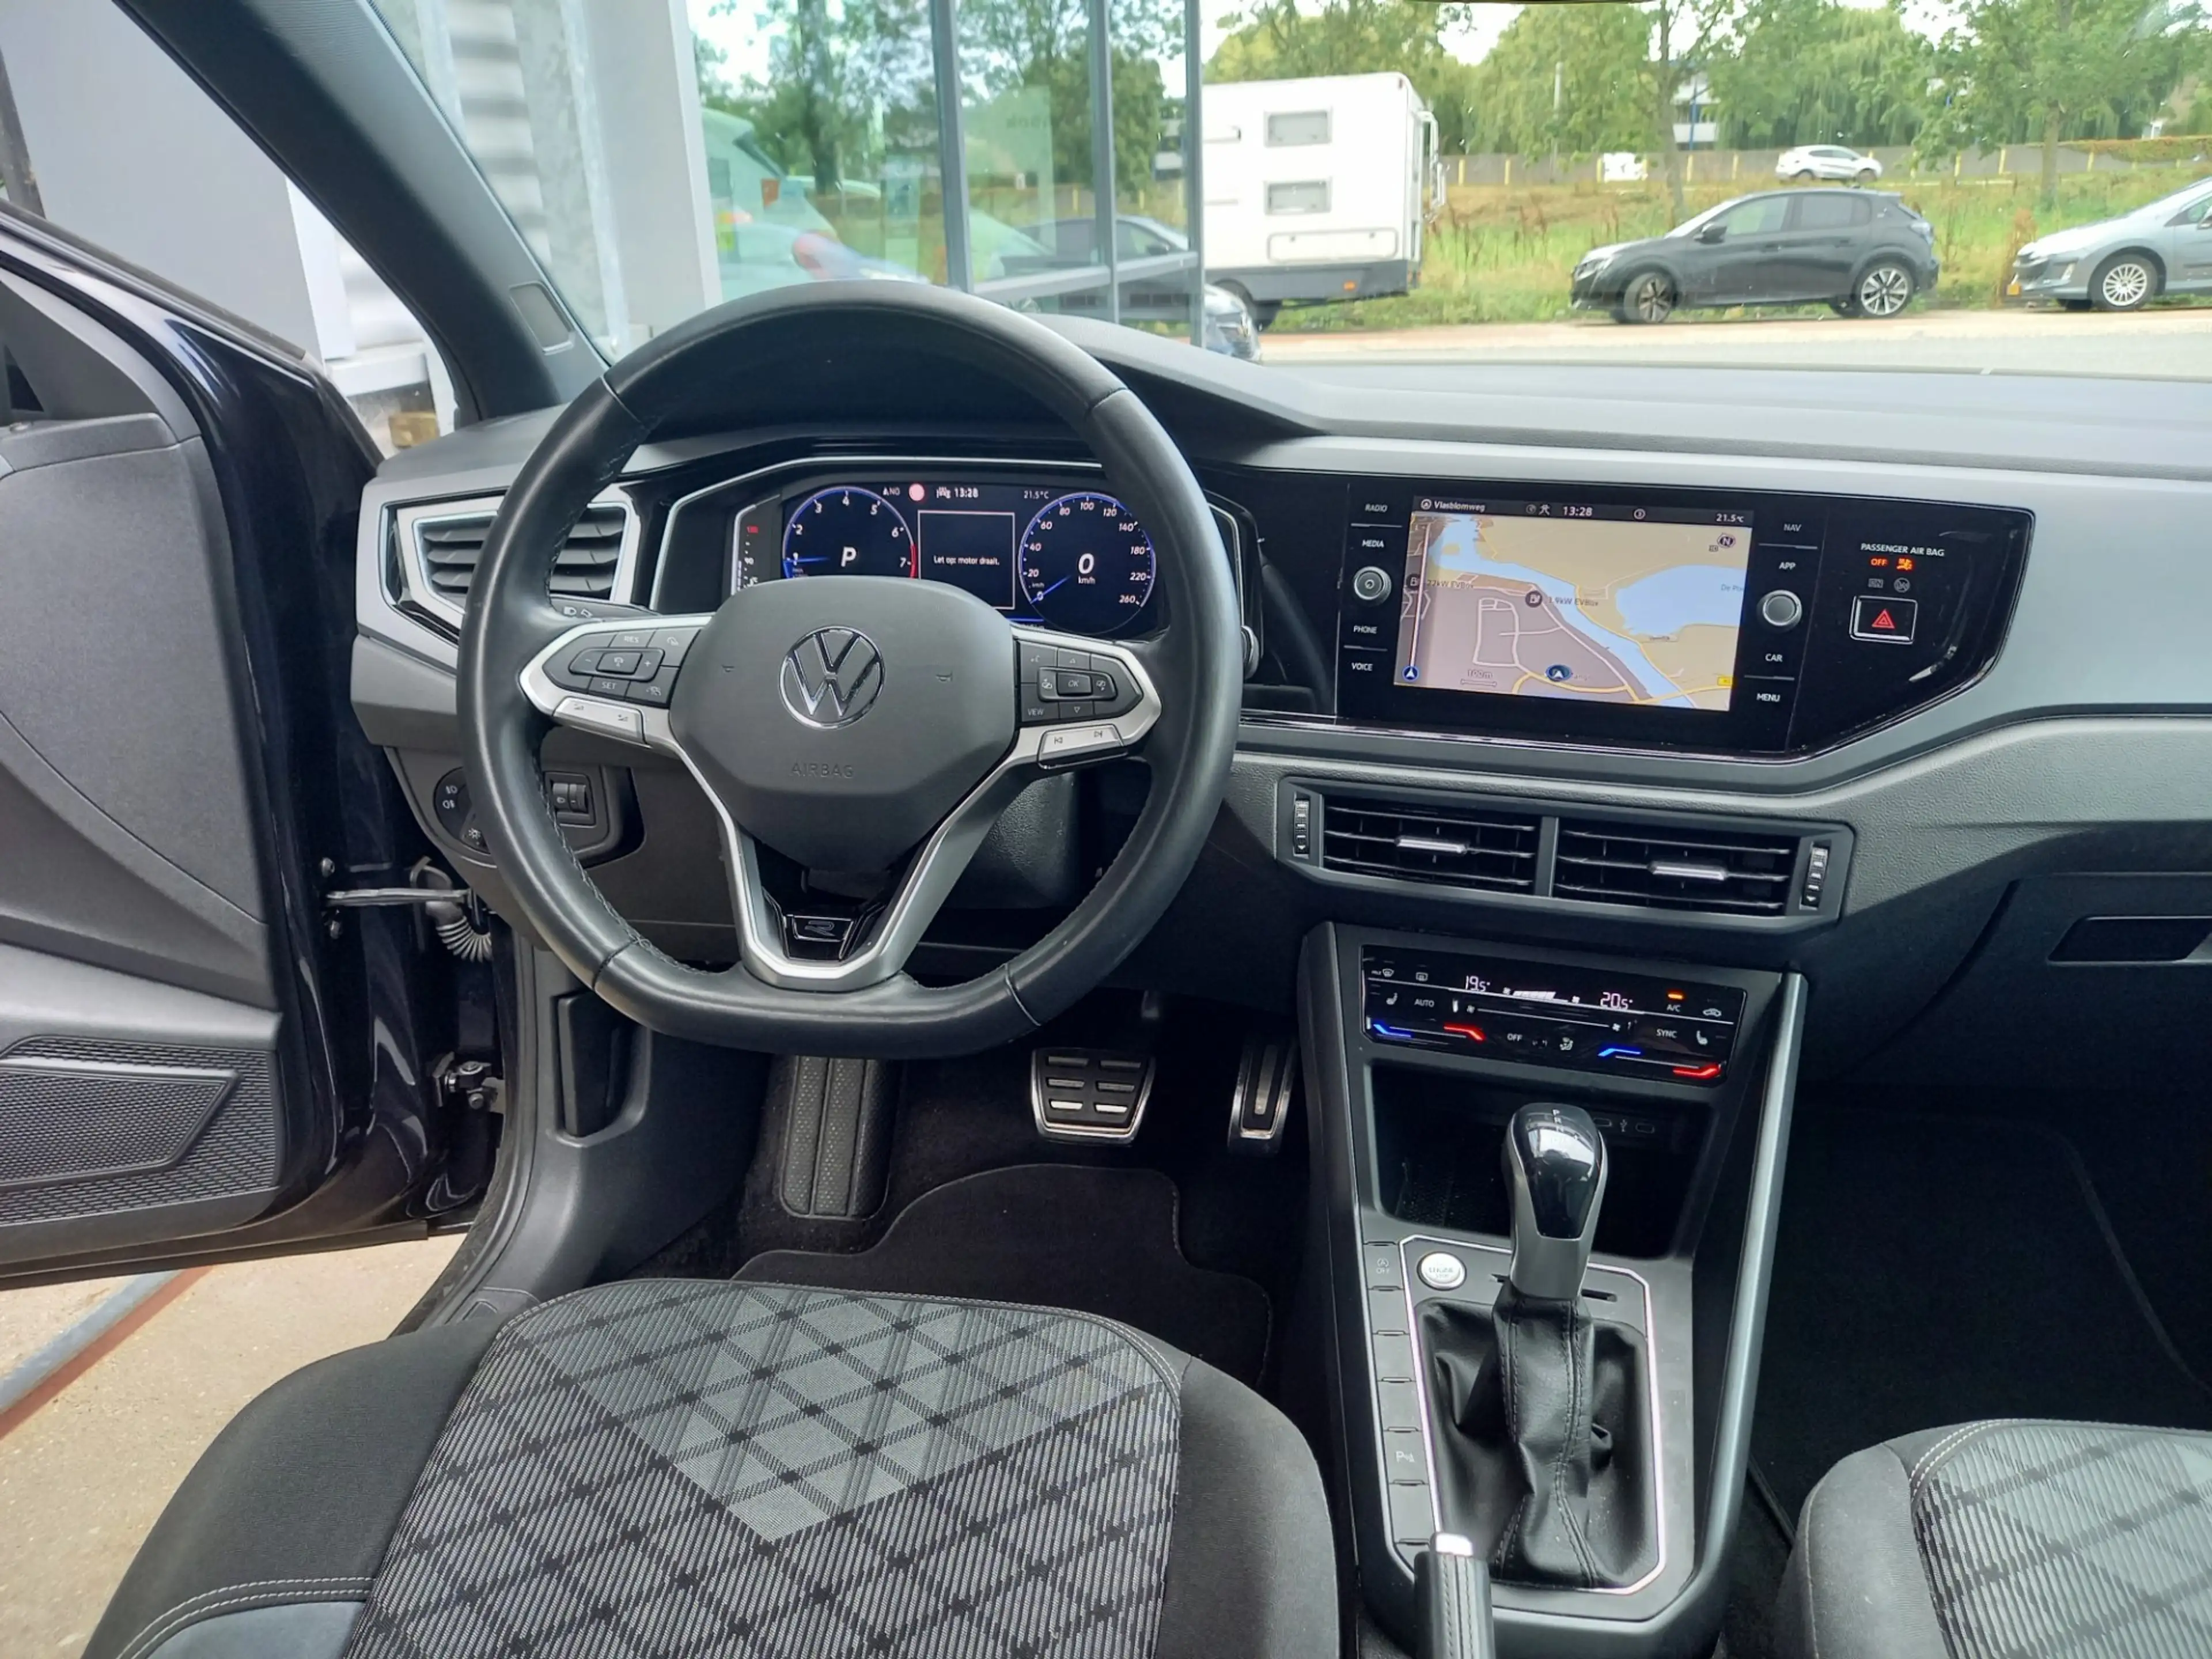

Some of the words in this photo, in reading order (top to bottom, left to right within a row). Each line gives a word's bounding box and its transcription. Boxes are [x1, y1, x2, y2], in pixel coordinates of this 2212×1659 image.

[955, 487, 979, 498] 13:28
[842, 496, 850, 506] 4
[815, 502, 822, 514] 3
[870, 504, 878, 515] 5
[1059, 507, 1070, 516] 80
[1080, 502, 1094, 511] 100
[1365, 503, 1388, 513] RADIO
[1562, 505, 1593, 517] 13:28
[1103, 507, 1118, 517] 120
[796, 524, 803, 535] 2
[1040, 521, 1053, 530] 60
[1119, 522, 1134, 532] 140
[1783, 523, 1801, 532] NAV
[891, 527, 899, 537] 6
[1029, 543, 1041, 552] 40
[1362, 539, 1385, 548] MEDIA
[1130, 546, 1145, 555] 180
[1861, 543, 1908, 554] PASSENGER
[1910, 547, 1925, 555] AIR
[1926, 548, 1945, 557] BAG
[840, 547, 857, 567] P
[900, 557, 907, 567] 7
[957, 556, 979, 565] motor
[1078, 553, 1094, 574] 0
[1778, 561, 1796, 570] APP
[1870, 558, 1888, 567] OFF
[1027, 569, 1040, 578] 20
[1130, 572, 1146, 581] 220
[1078, 577, 1096, 585] km/h
[1119, 594, 1136, 604] 260
[1353, 626, 1377, 634] PHONE
[623, 635, 640, 645] RES
[1764, 653, 1783, 662] CAR
[1351, 662, 1373, 672] VOICE
[601, 681, 616, 690] SET
[1067, 679, 1079, 688] OK
[1756, 693, 1781, 703] MENU
[1027, 707, 1044, 717] VIEW
[790, 762, 855, 778] AIRBAG
[1414, 998, 1435, 1008] AUTO
[1666, 1004, 1681, 1013] A/C
[1506, 1033, 1522, 1041] OFF
[1656, 1028, 1677, 1038] SYNC
